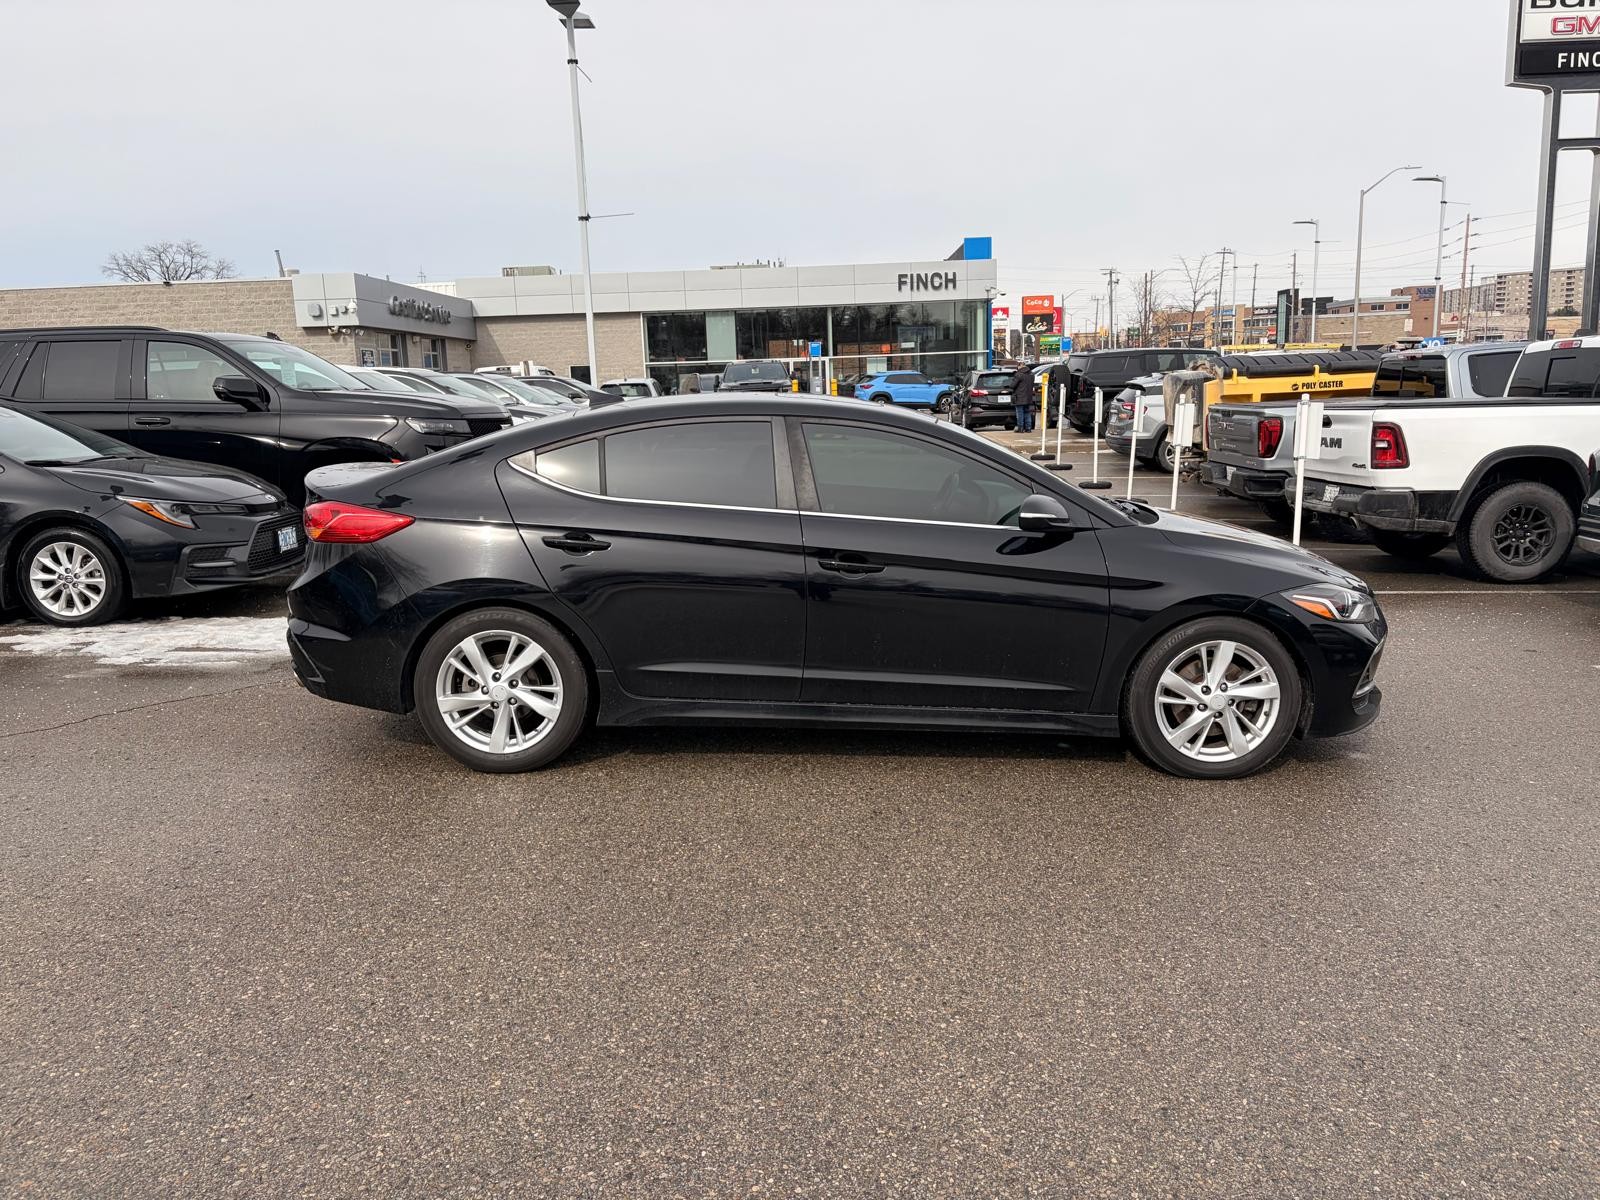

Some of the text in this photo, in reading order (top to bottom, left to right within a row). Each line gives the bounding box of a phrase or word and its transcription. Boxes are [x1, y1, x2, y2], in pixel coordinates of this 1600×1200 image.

[898, 272, 956, 291] FINCH
[1301, 380, 1344, 390] POLY CASTER
[1320, 437, 1342, 448] AM
